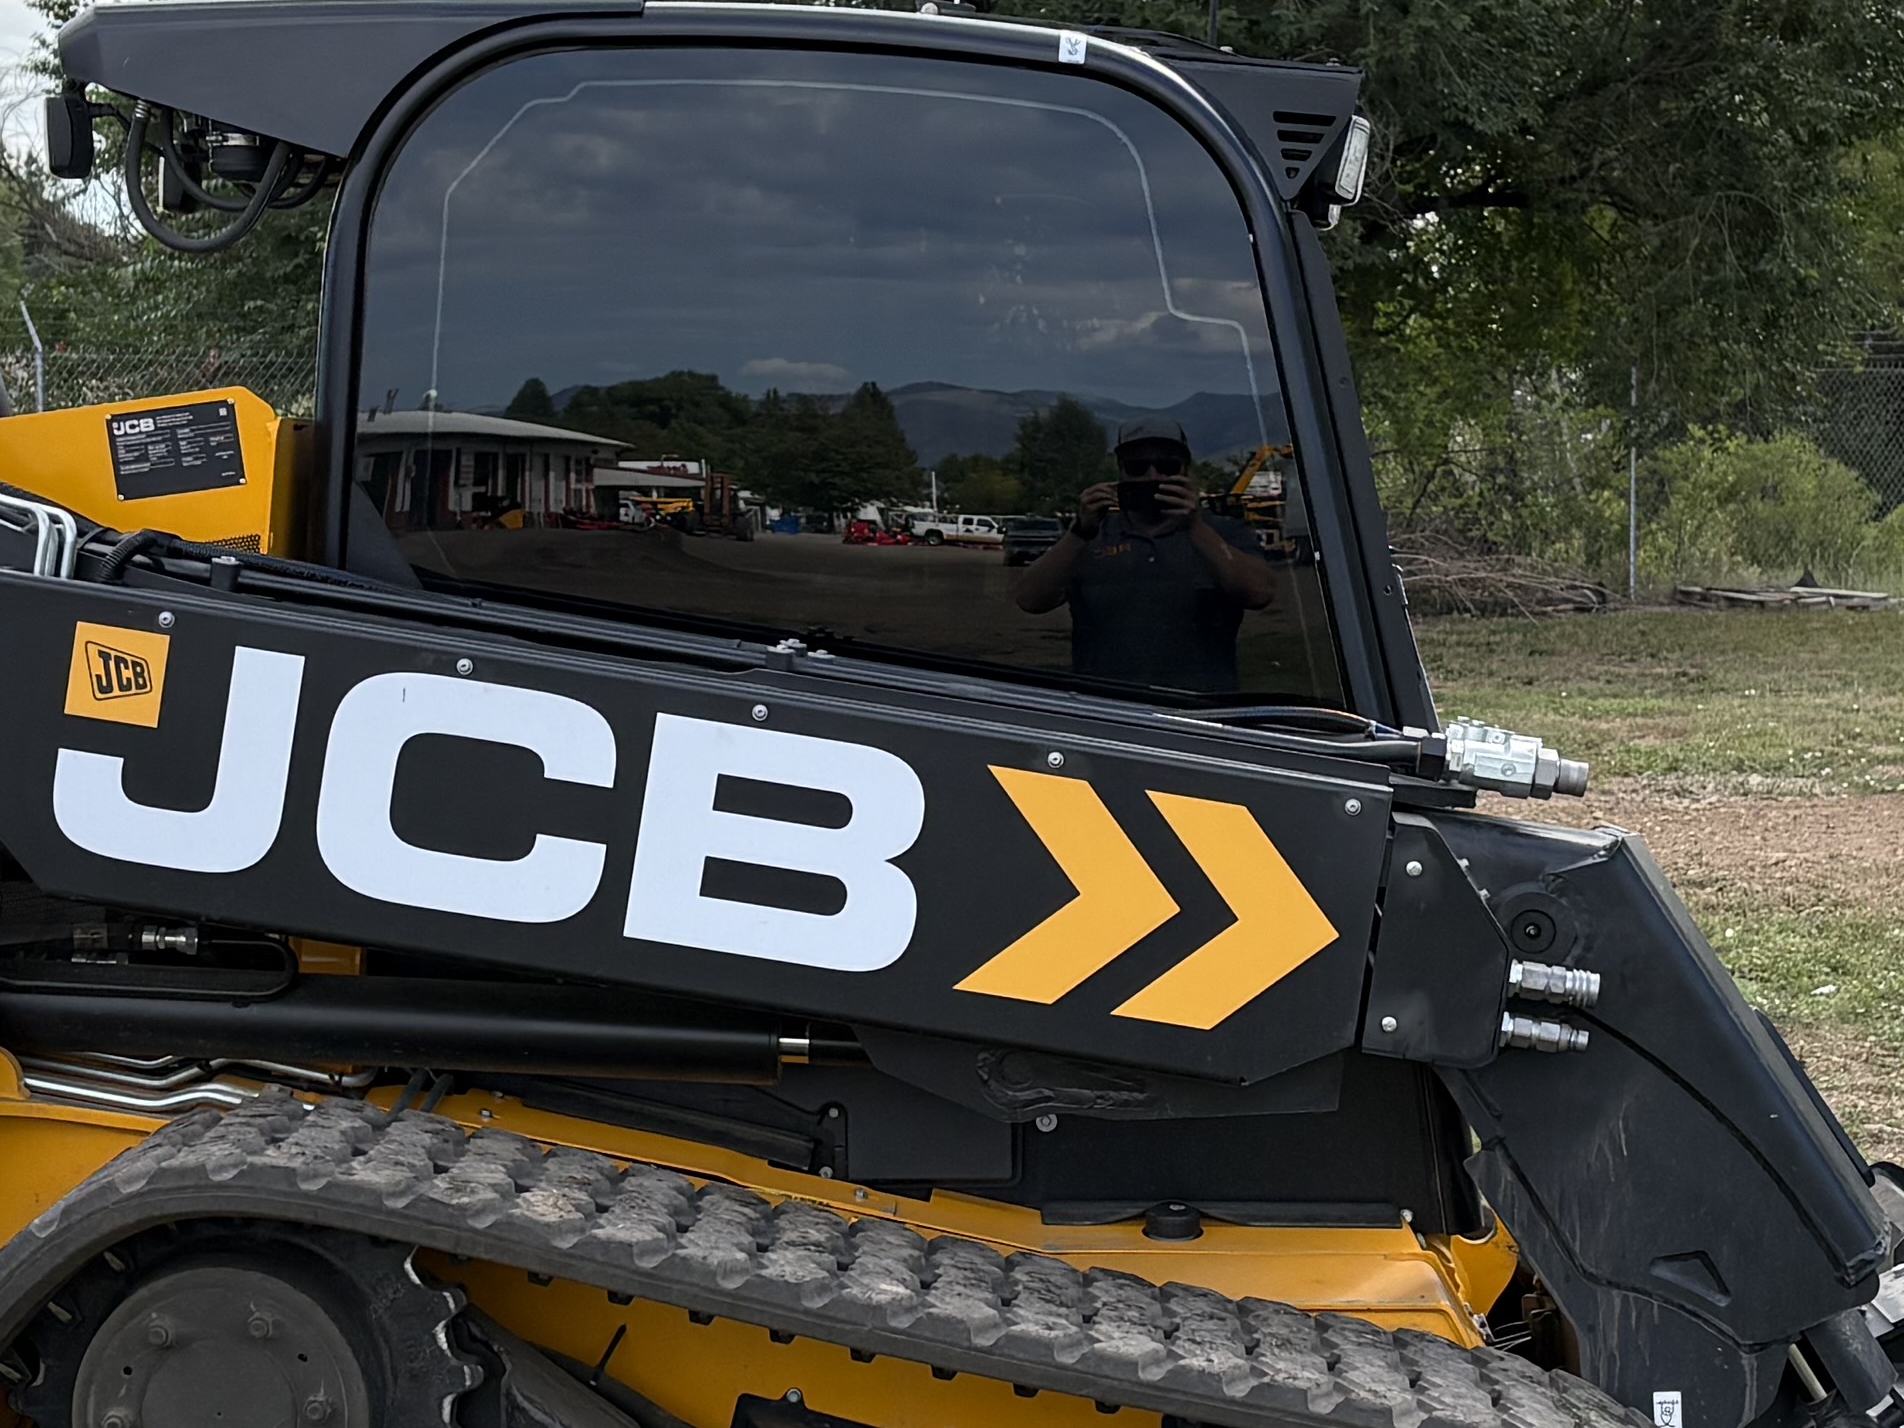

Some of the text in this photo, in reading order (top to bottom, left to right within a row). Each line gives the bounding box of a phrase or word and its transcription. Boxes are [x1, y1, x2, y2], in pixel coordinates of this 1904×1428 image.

[113, 418, 155, 435] JCB
[95, 649, 148, 694] JCB
[53, 646, 924, 971] JCB
